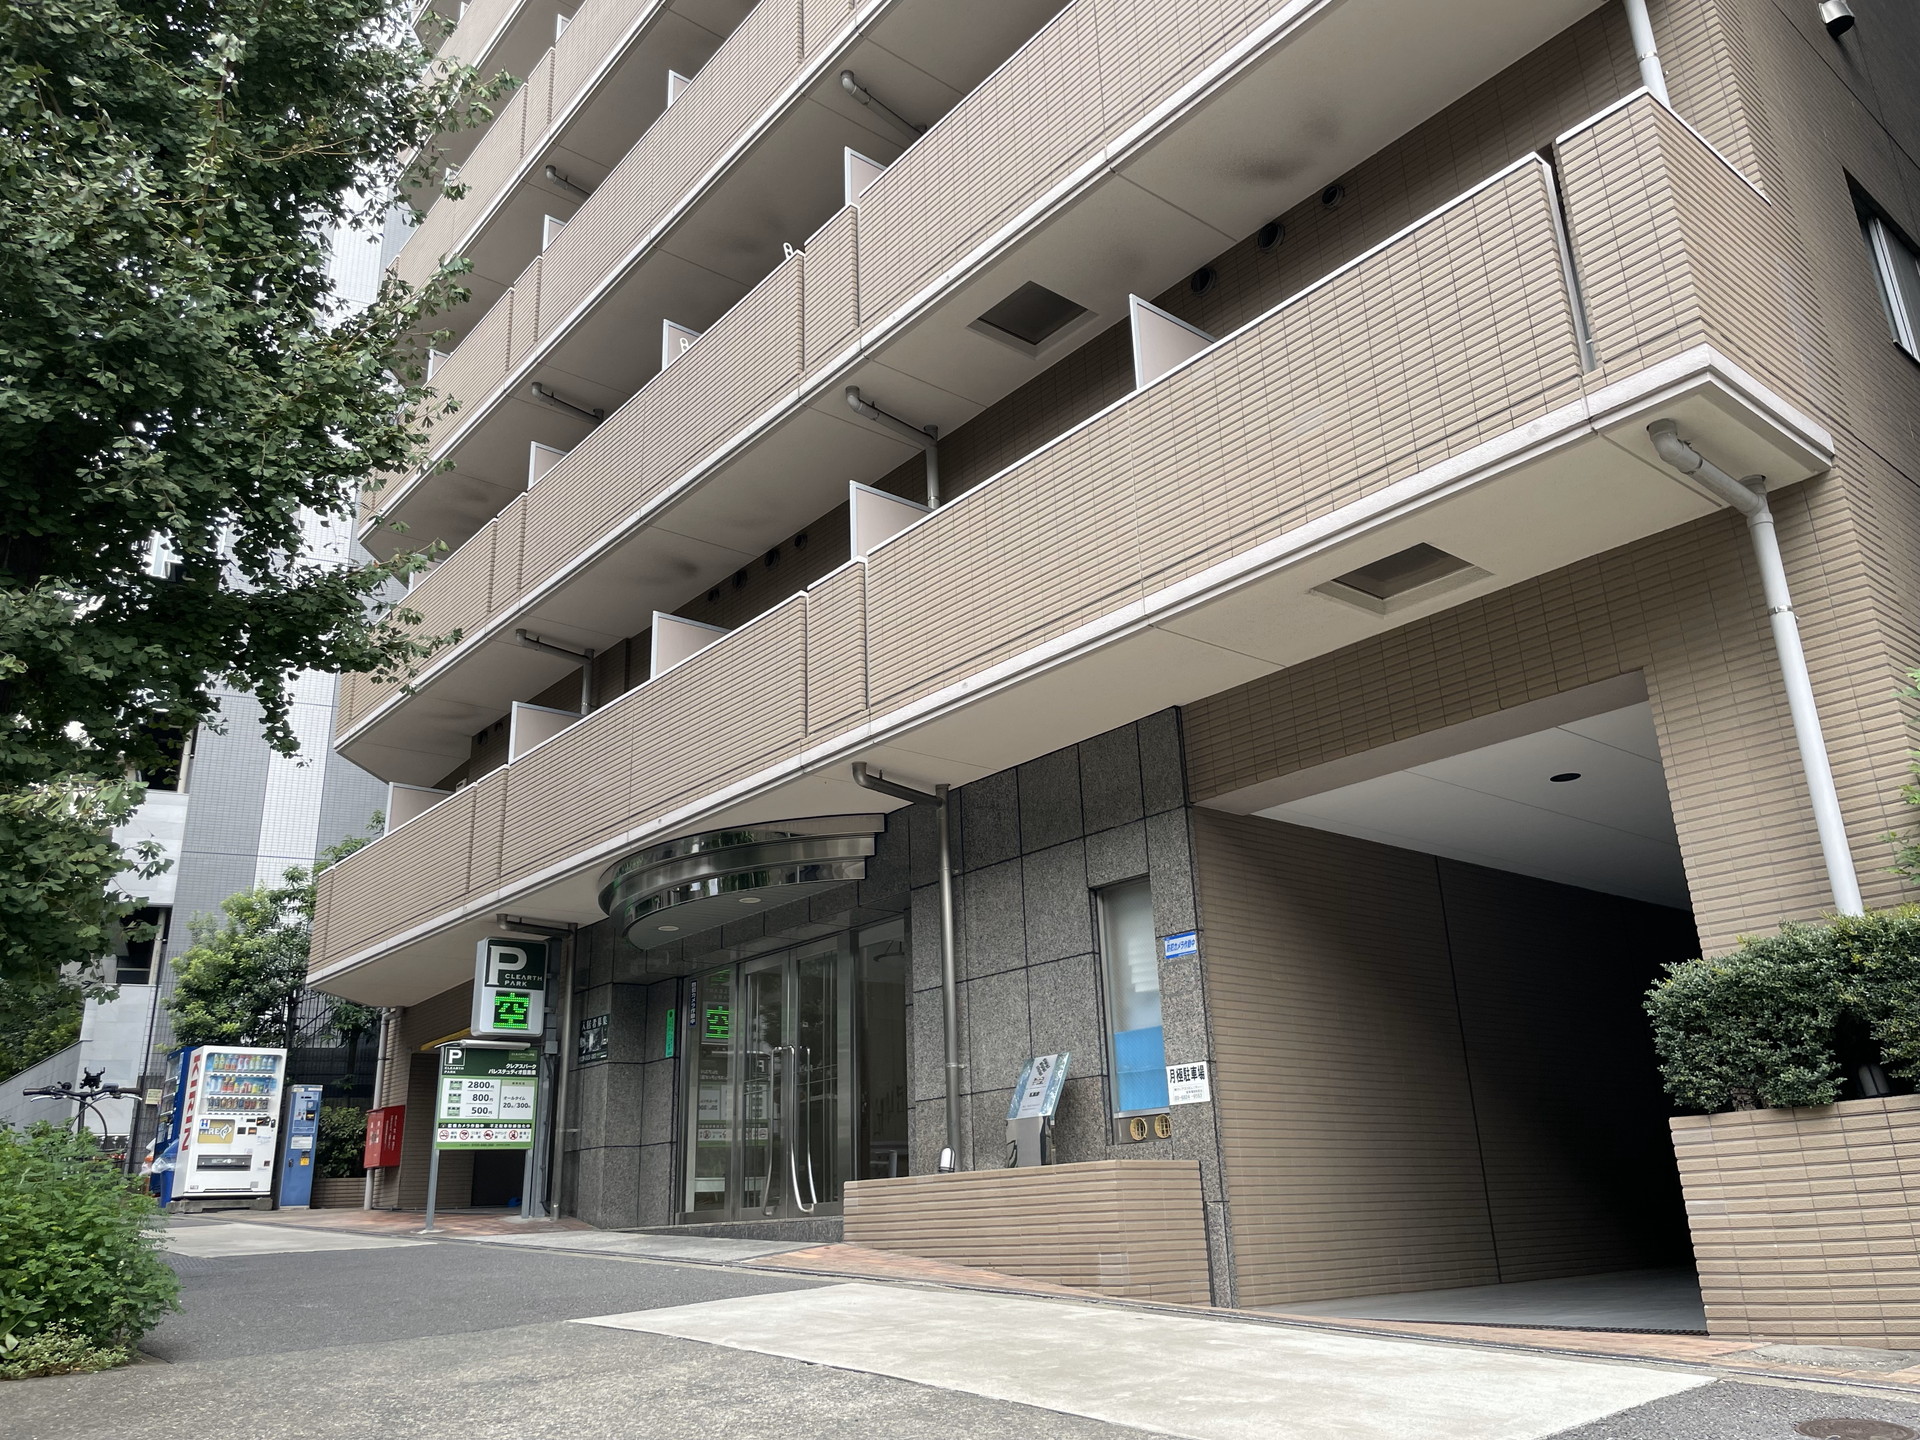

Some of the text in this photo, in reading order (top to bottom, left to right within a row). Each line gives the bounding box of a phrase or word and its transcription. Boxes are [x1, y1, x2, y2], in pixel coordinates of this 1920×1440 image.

[487, 945, 527, 985] P
[504, 973, 543, 981] CLEARTH
[493, 992, 529, 1029] 空
[448, 1049, 462, 1064] P
[1170, 1064, 1206, 1083] 月極駐車場
[182, 1055, 201, 1151] KIRIN
